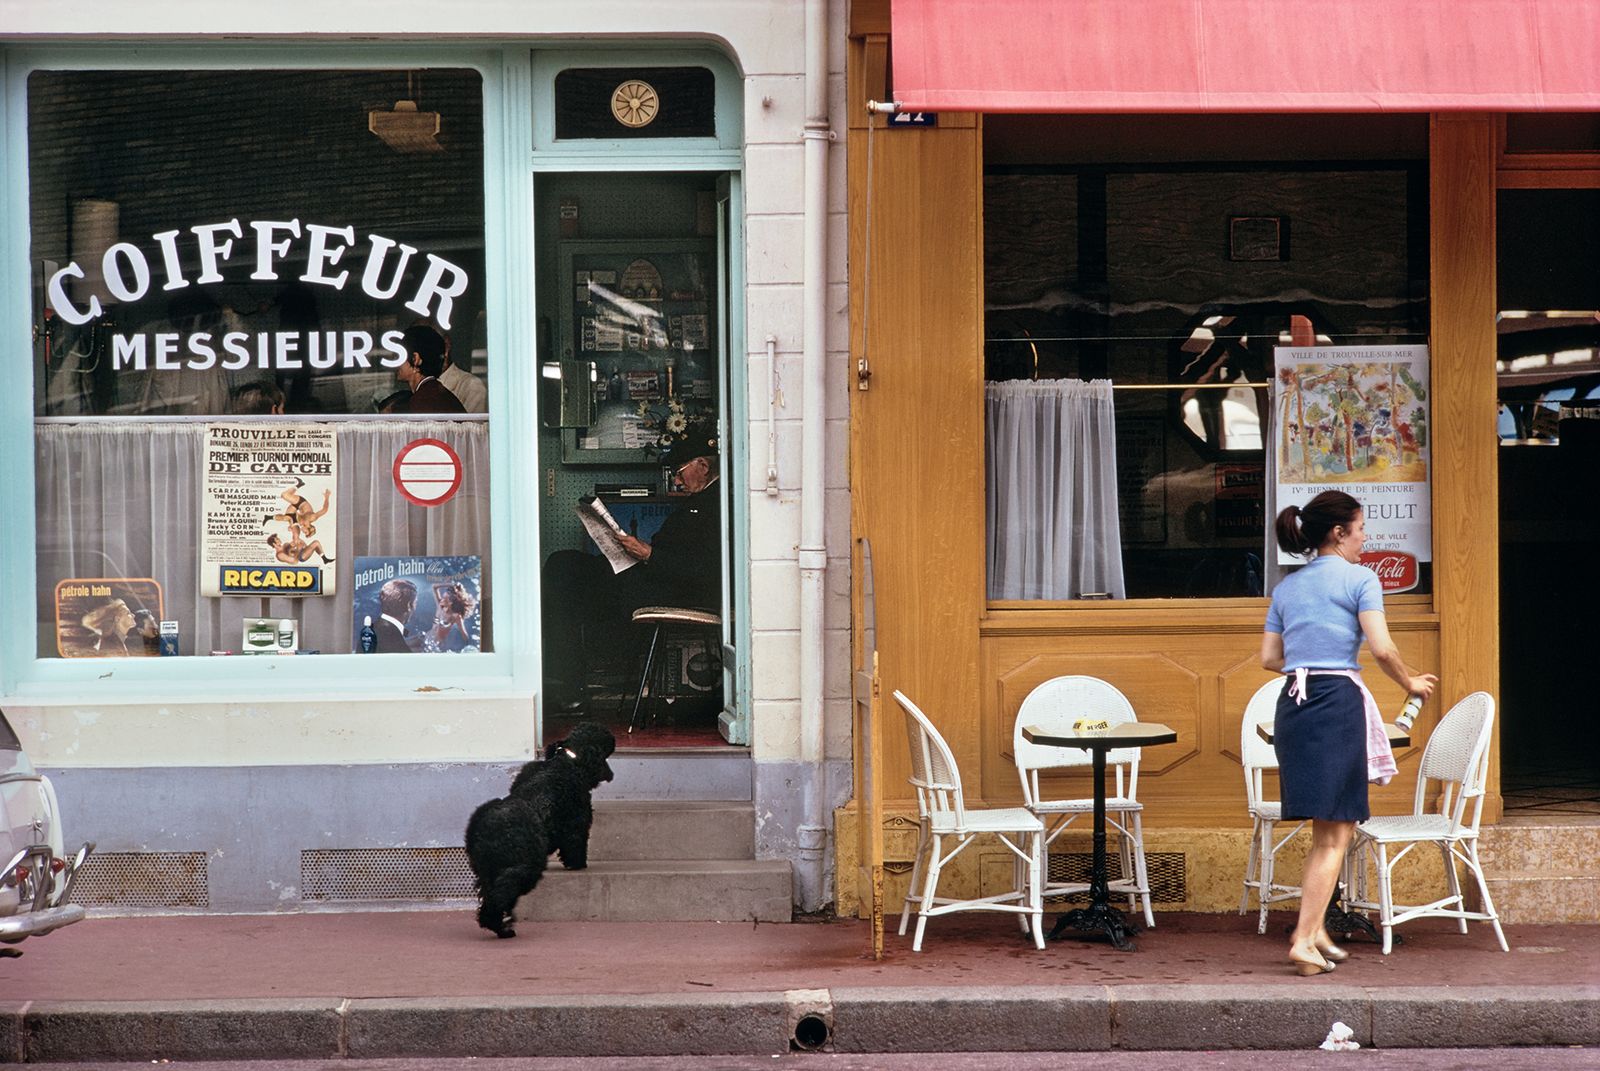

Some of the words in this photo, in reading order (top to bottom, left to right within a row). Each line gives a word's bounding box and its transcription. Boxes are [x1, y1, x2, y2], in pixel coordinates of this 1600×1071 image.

[48, 217, 470, 330] COIFFEUR
[111, 330, 408, 371] MESSIEURS
[210, 427, 296, 440] TROUVILLE
[209, 451, 249, 462] PREMIER
[252, 452, 290, 463] TOURNOI
[291, 452, 332, 463] MONDIAL
[208, 462, 241, 473] DE
[250, 463, 332, 474] CATCH
[1371, 485, 1414, 493] PEINTURE
[224, 569, 314, 589] RICARD
[355, 562, 394, 590] pétrole
[398, 559, 425, 576] hahn
[61, 584, 90, 600] pétrole
[92, 585, 112, 597] hahn
